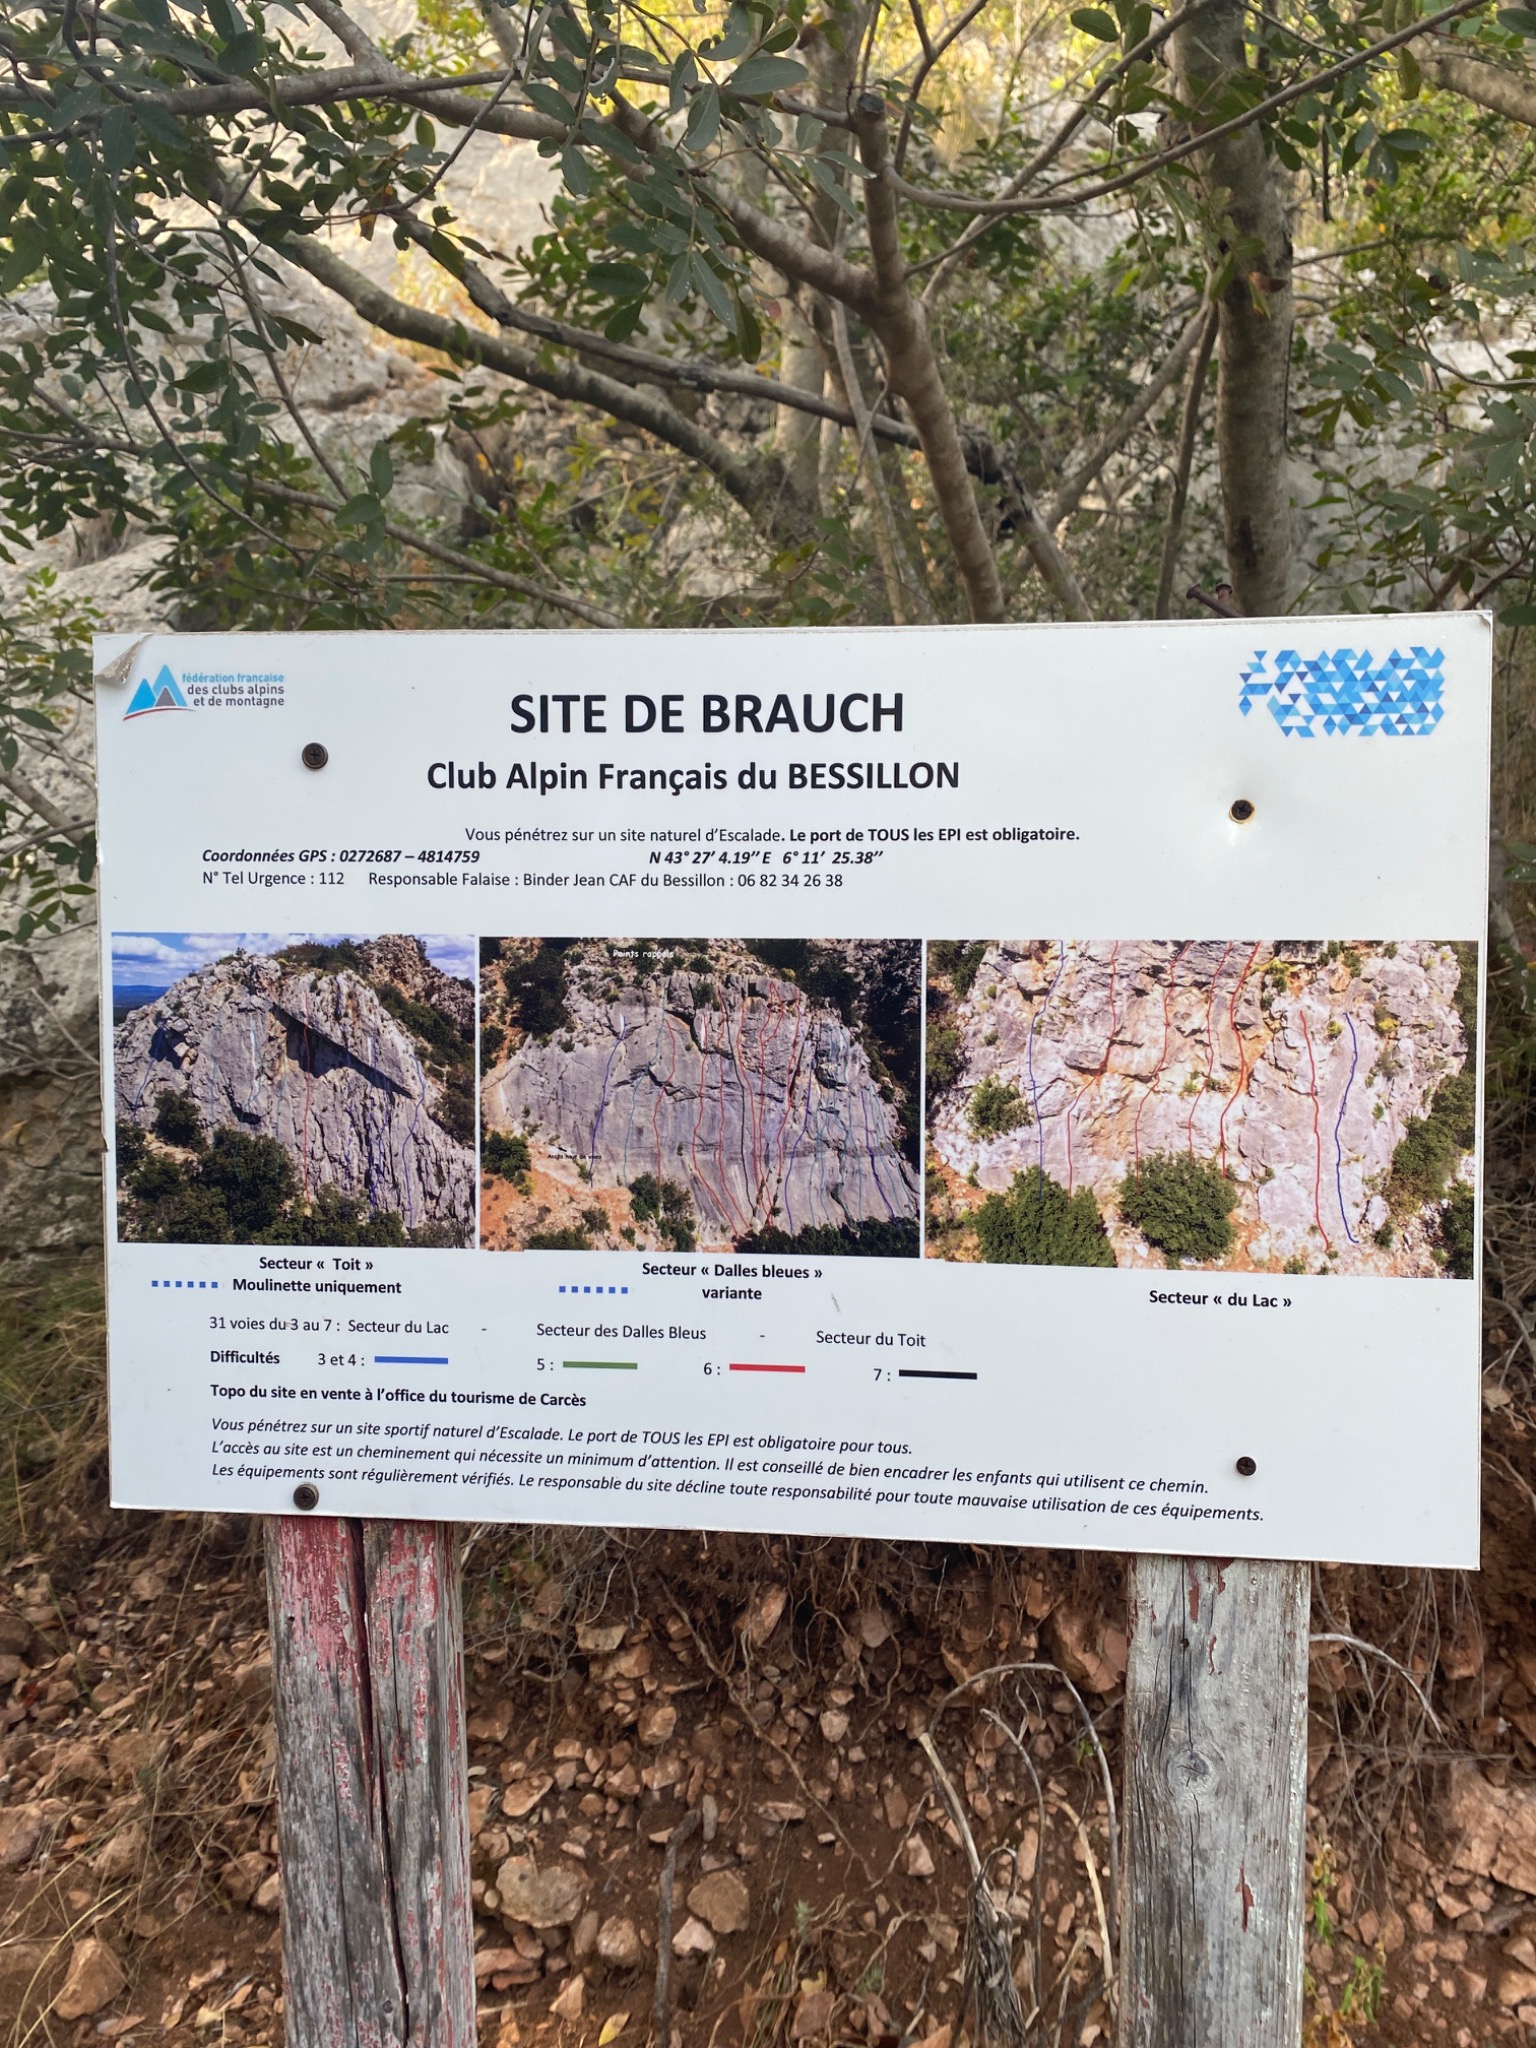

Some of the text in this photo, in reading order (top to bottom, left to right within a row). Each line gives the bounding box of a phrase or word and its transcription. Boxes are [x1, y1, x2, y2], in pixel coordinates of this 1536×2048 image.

[182, 673, 284, 685] fédération française
[187, 683, 285, 696] des clubs alpins
[193, 696, 285, 709] et de montagne
[510, 692, 904, 735] SITE DE BRAUCH
[426, 760, 960, 797] Club Alpin Français du BESSILLON
[464, 827, 501, 842] Vous
[504, 826, 569, 845] pénétrez
[571, 830, 595, 842] sur
[598, 831, 617, 842] un
[619, 828, 646, 842] site
[650, 827, 701, 842] naturel
[789, 828, 807, 842] Le
[809, 829, 842, 845] port
[845, 827, 865, 842] de
[866, 828, 910, 842] TOUS
[913, 827, 935, 842] les
[938, 827, 962, 842] EPI
[965, 828, 989, 842] est
[991, 826, 1080, 844] obligatoire.
[201, 848, 481, 864] Coordonnées GPS 0272687 4814759
[648, 850, 662, 865] N
[761, 850, 772, 865] E
[221, 870, 244, 885] Tel
[247, 871, 307, 888] Urgence
[319, 871, 345, 885] 112
[368, 871, 844, 889] Responsable Falaise Binder Jean CAF du Bessillon 06 82 34 26 38
[258, 1256, 362, 1272] Secteur Toit
[641, 1261, 810, 1279] Secteur Dalles bleues
[232, 1277, 403, 1296] Moulinette uniquement
[701, 1285, 763, 1301] variante
[1148, 1289, 1279, 1309] Secteur du Lac
[209, 1315, 450, 1335] 31 voies du 3 au 7 Secteur du Lac
[536, 1322, 707, 1340] Secteur des Dalles Bleus
[815, 1330, 927, 1348] Secteur du Toit
[209, 1349, 281, 1365] Difficultés
[317, 1352, 357, 1367] 3 et 4
[536, 1357, 546, 1372] 5
[703, 1361, 713, 1376] 6
[872, 1367, 883, 1382] 7
[209, 1383, 246, 1400] Topo
[249, 1384, 268, 1398] du
[270, 1385, 297, 1399] site
[299, 1389, 318, 1400] en
[320, 1388, 362, 1401] vente
[364, 1387, 374, 1401] à
[428, 1389, 448, 1403] du
[450, 1390, 515, 1405] tourisme
[518, 1391, 537, 1406] de
[539, 1392, 587, 1407] Carcès
[211, 1417, 245, 1432] Vous
[246, 1418, 308, 1435] pénétrez
[355, 1421, 381, 1436] site
[383, 1423, 432, 1440] sportif
[432, 1424, 484, 1439] naturel
[586, 1430, 618, 1445] port
[642, 1430, 682, 1446] TOUS
[707, 1432, 730, 1447] EPI
[757, 1434, 837, 1453] obligatoire
[838, 1441, 875, 1455] pour
[877, 1440, 913, 1455] tous.
[356, 1444, 451, 1461] cheminement
[453, 1448, 477, 1465] qui
[478, 1448, 543, 1464] nécessite
[567, 1451, 634, 1467] minimum
[761, 1460, 824, 1475] conseillé
[848, 1462, 880, 1478] bien
[883, 1465, 951, 1481] encadrer
[975, 1469, 1033, 1487] enfants
[1035, 1472, 1061, 1489] qui
[1063, 1473, 1126, 1490] utilisent
[1149, 1477, 1209, 1494] chemin.
[211, 1463, 1264, 1522] Les équipements sont régulièrement vérifiés. responsable site décline toute responsabilité pour toute mauvaise utilisation équipements.
